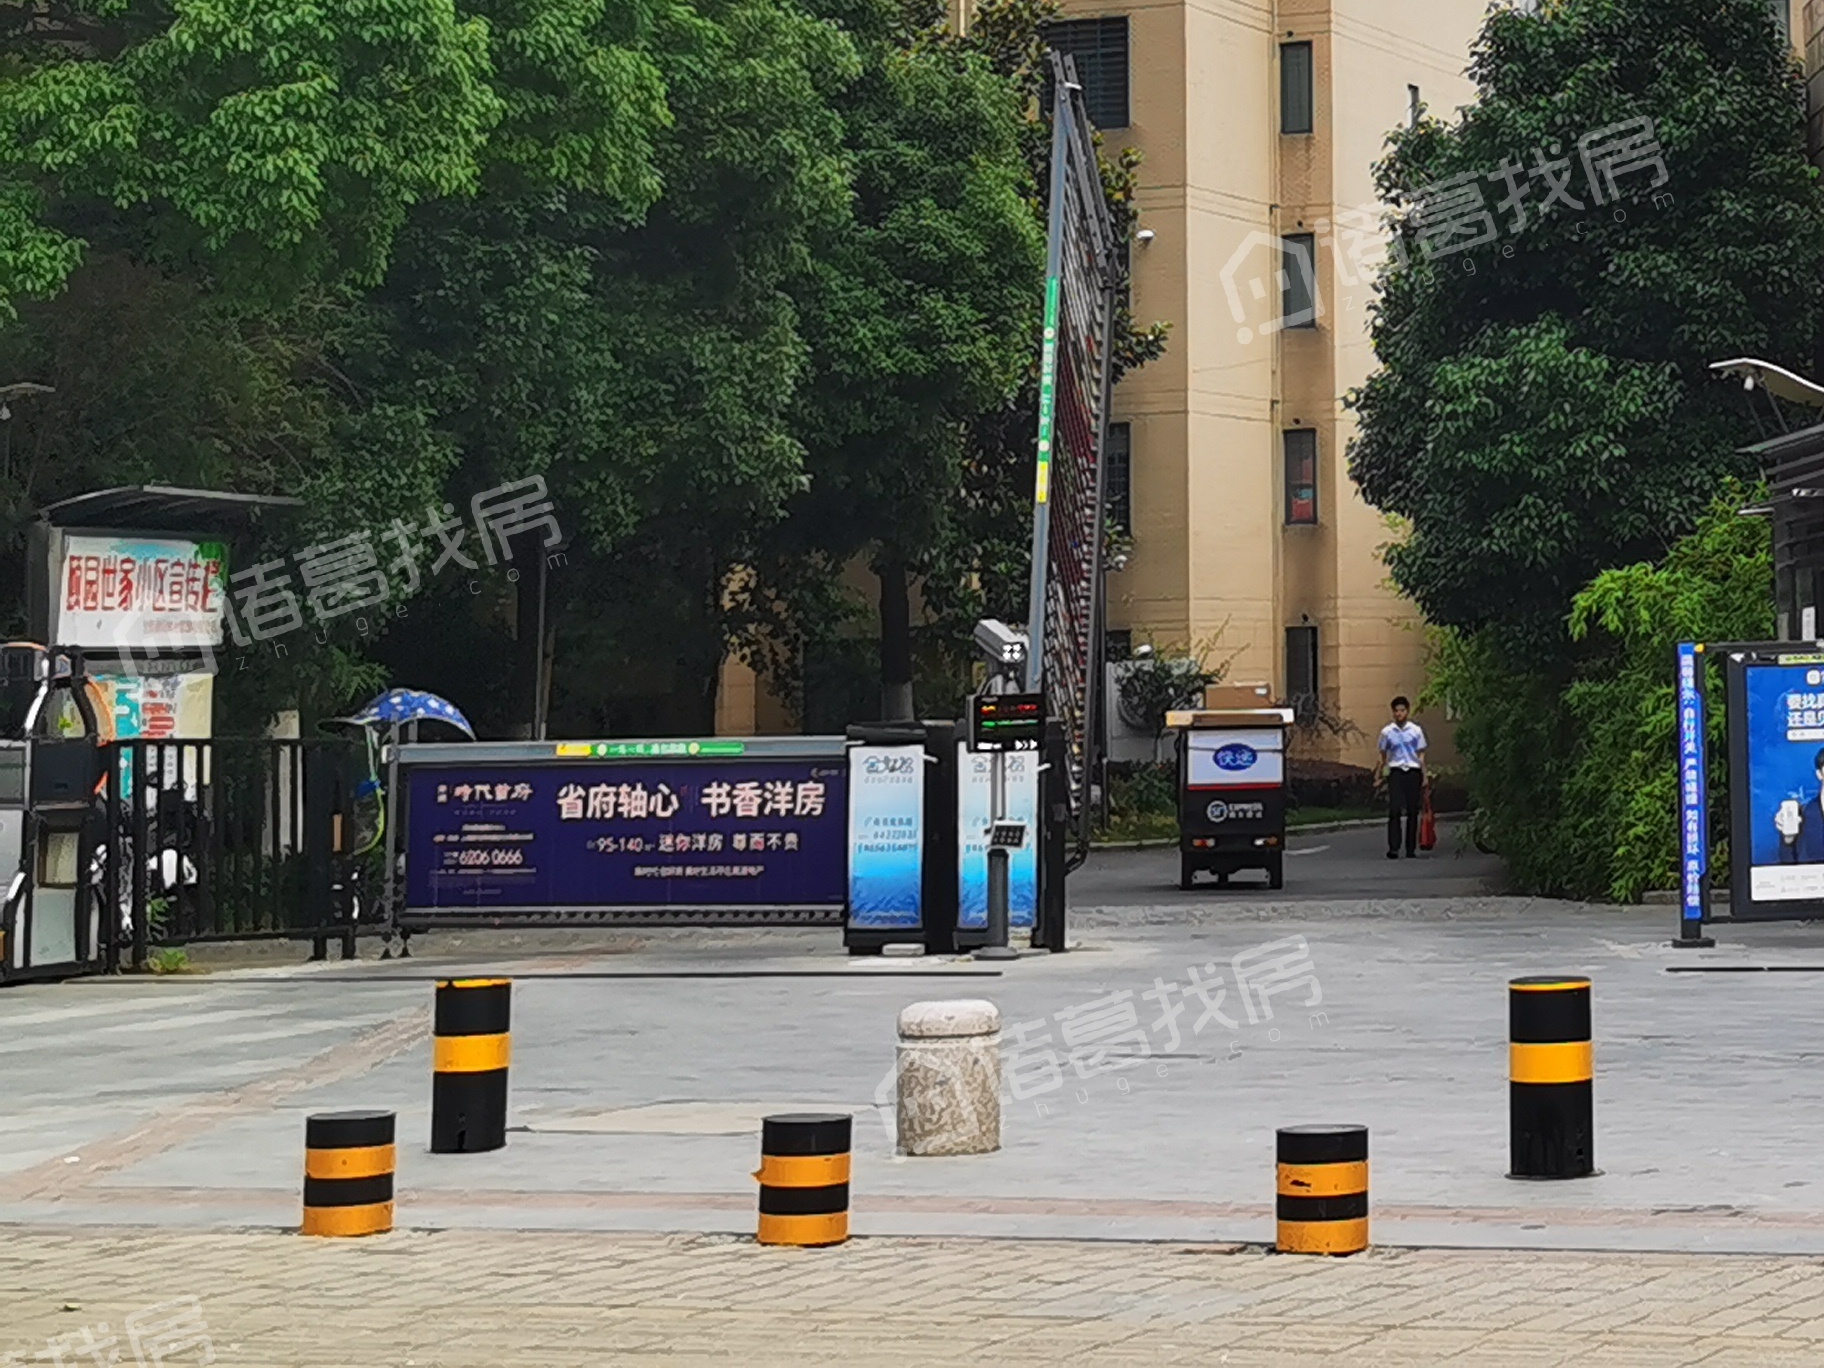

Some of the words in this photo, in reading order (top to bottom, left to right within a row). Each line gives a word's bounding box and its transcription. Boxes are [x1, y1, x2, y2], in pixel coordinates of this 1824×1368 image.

[557, 784, 680, 820] 省府轴心
[701, 781, 826, 818] 书香洋房
